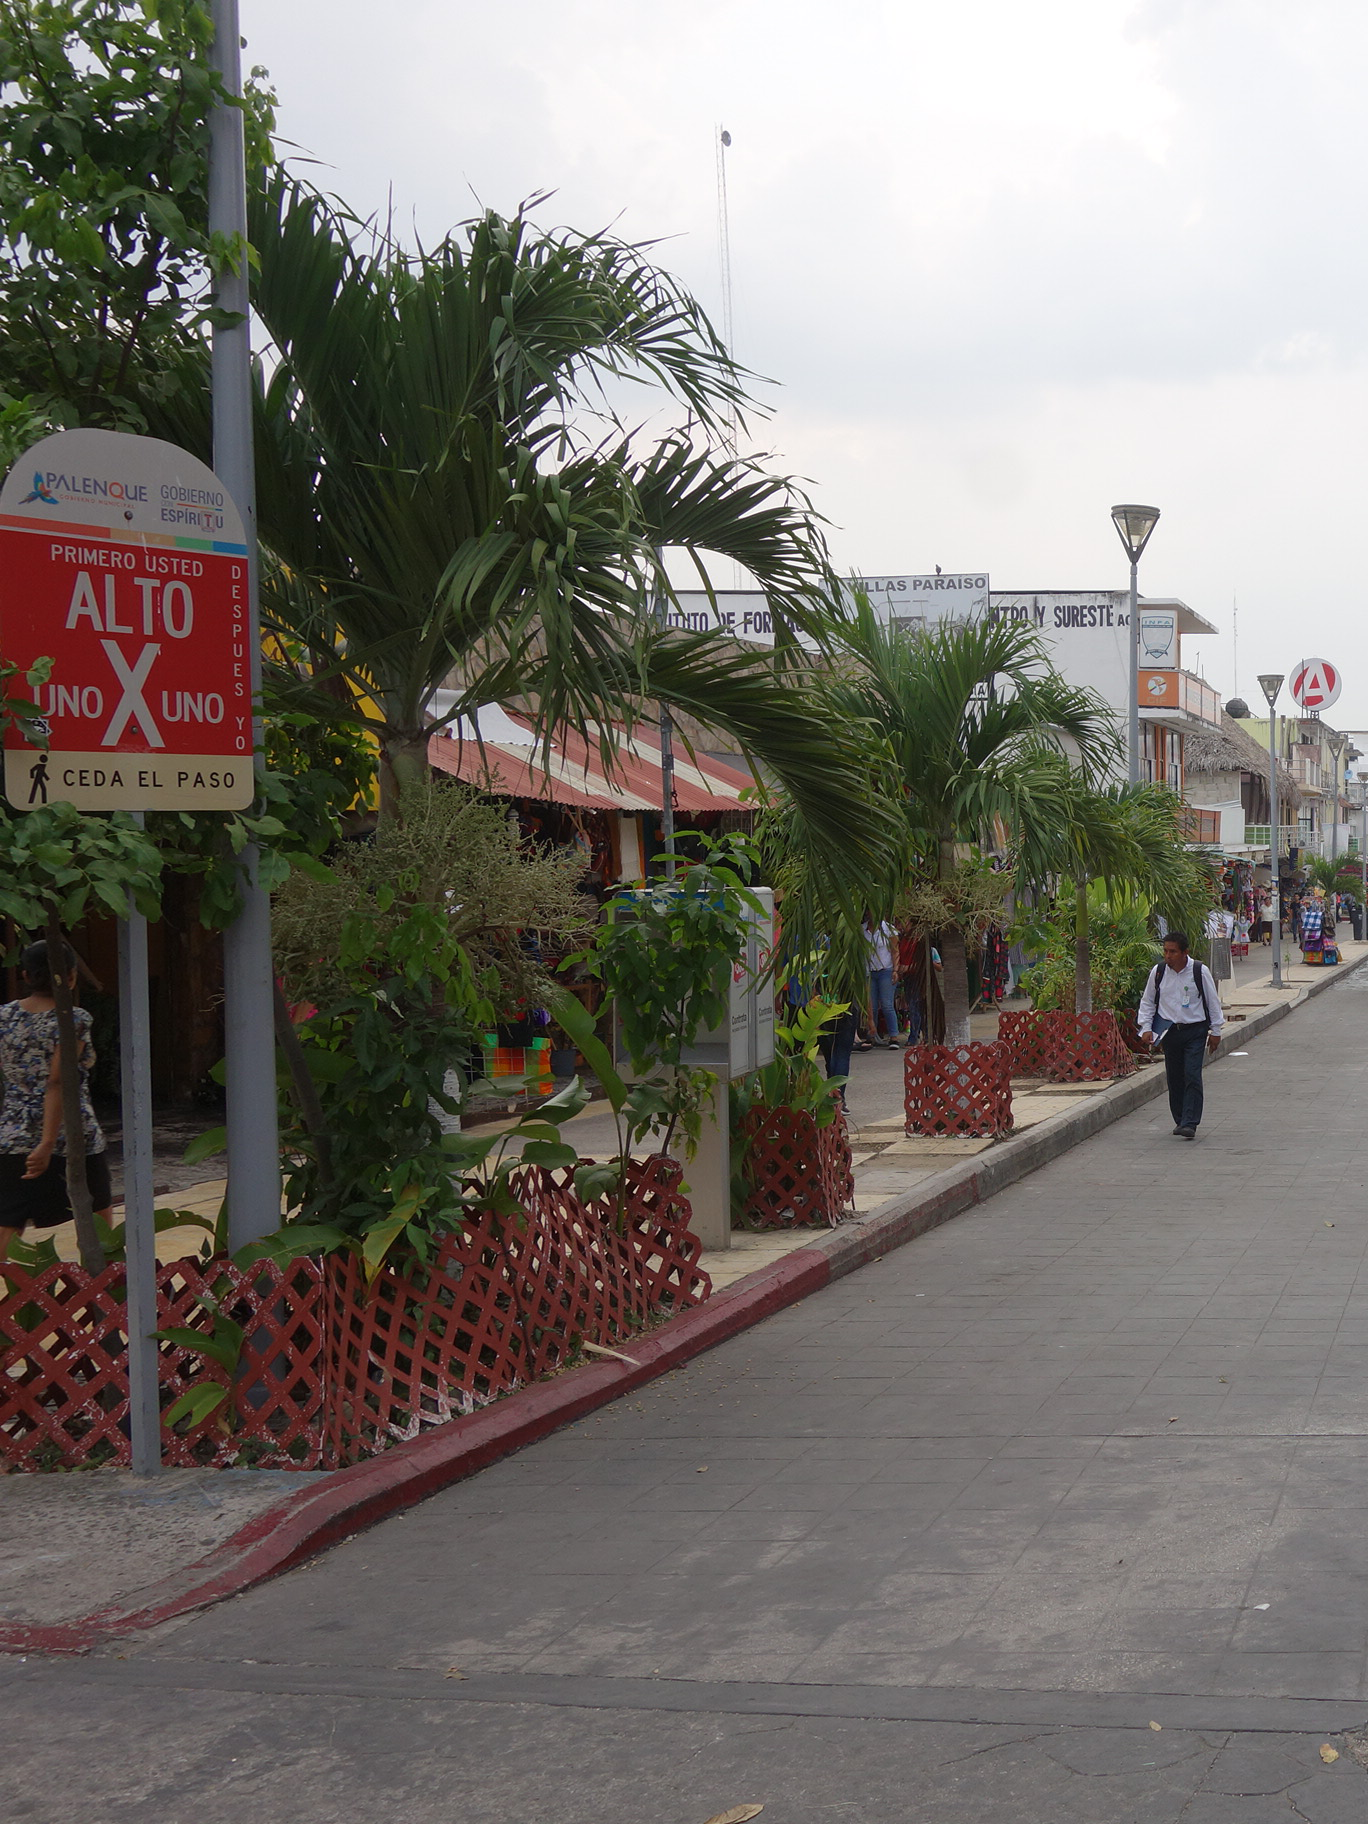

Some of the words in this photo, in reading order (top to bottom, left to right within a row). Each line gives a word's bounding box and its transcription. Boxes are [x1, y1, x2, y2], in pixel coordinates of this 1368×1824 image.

[46, 472, 148, 502] PALENQUE
[161, 484, 224, 507] GOBIERNO
[161, 507, 224, 532] ESPÍRITU
[51, 543, 136, 570] PRIMERO
[145, 554, 204, 577] USTED
[912, 576, 987, 591] PARAÍSO
[65, 571, 194, 639] ALTO
[1053, 604, 1114, 628] SURESTE
[100, 639, 166, 748] X
[162, 690, 225, 724] UNO
[63, 769, 124, 787] CEDA
[138, 771, 163, 788] EL
[178, 772, 235, 788] PASO
